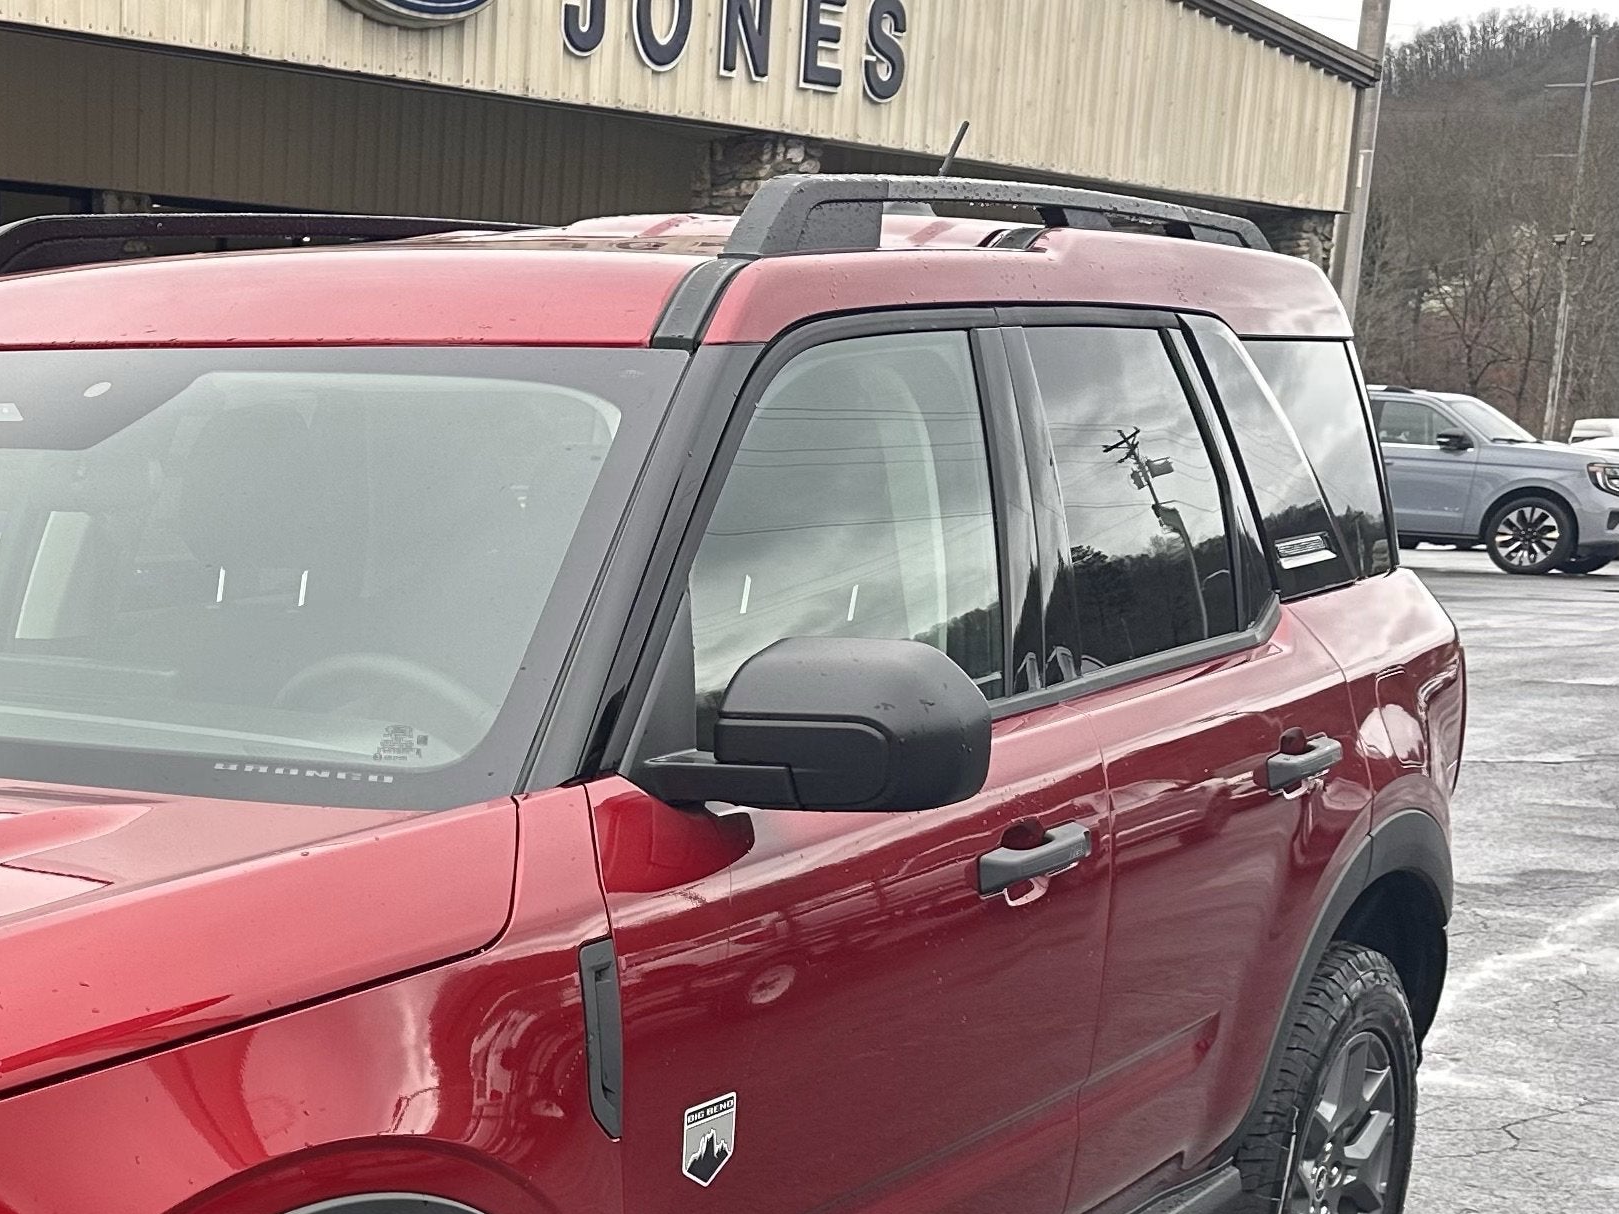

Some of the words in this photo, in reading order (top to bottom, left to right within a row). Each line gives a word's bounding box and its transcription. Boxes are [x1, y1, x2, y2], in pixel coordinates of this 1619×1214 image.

[562, 0, 907, 104] JONES
[687, 1110, 705, 1124] BIG
[707, 1098, 734, 1119] BEND
